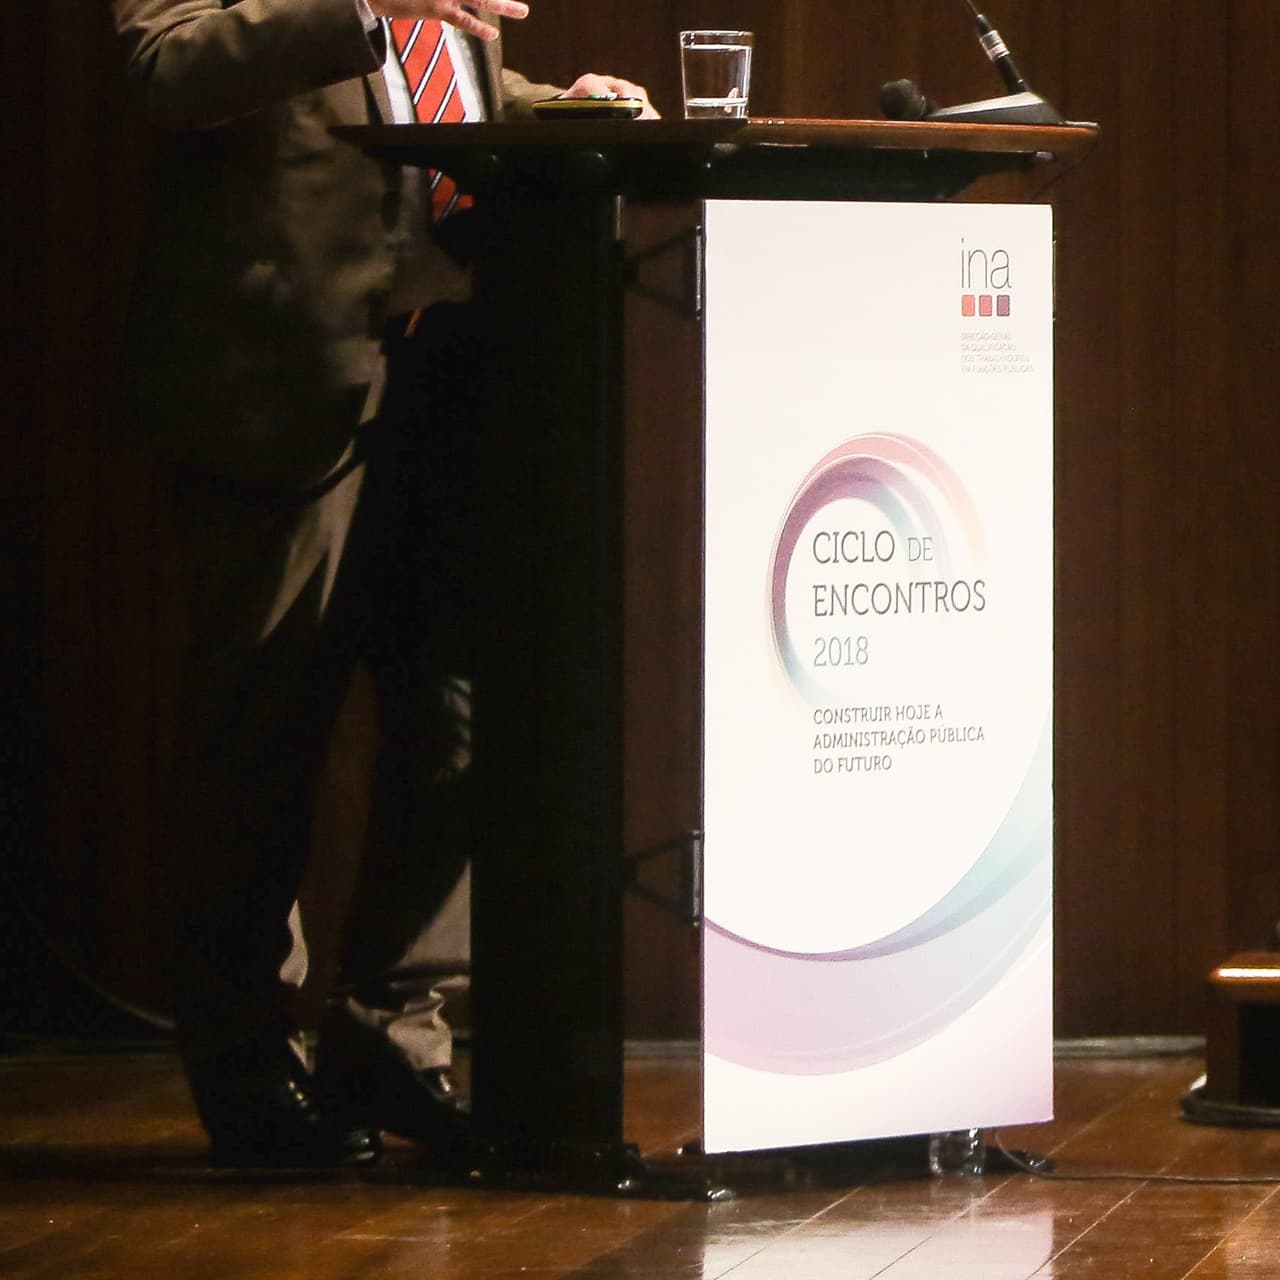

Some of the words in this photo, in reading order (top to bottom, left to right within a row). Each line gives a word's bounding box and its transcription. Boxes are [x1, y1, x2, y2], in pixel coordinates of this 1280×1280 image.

[961, 236, 1012, 289] ina
[812, 530, 895, 564] CICLO
[907, 536, 933, 562] DE
[812, 580, 986, 616] ENCONTROS
[813, 636, 869, 667] 2018
[813, 706, 892, 725] CONSTRUIR
[895, 704, 931, 721] HOJE
[934, 704, 943, 719] A
[813, 726, 926, 749] ADMINISTRAÇÃO
[930, 724, 985, 743] PÚBLICA
[813, 758, 834, 774] DO
[838, 755, 892, 773] FUTURO
